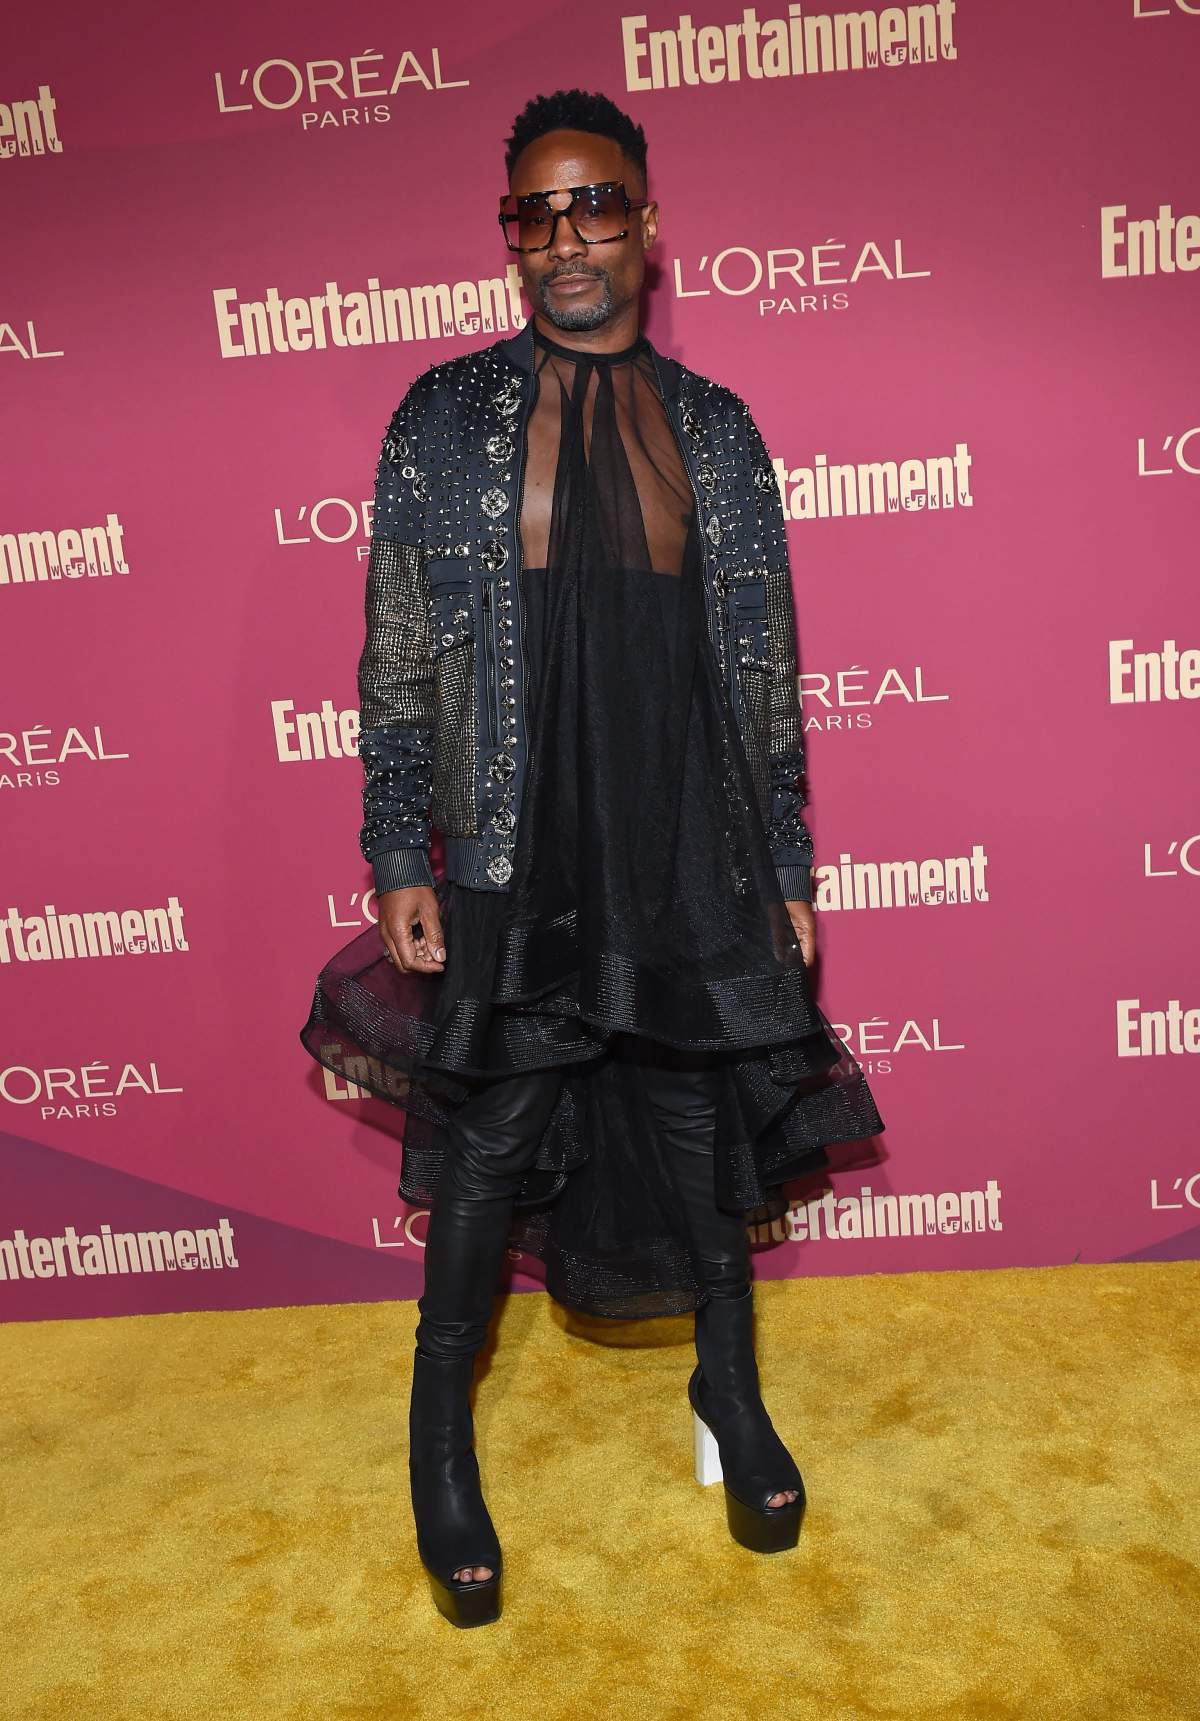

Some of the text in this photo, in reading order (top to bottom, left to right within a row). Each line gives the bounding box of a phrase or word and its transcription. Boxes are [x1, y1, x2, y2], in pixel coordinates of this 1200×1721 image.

[621, 0, 957, 92] Entertainment
[867, 43, 951, 65] WEEKLY
[214, 48, 470, 113] L'ORÉAL
[673, 238, 931, 298] L'ORÉAL
[213, 264, 526, 359] Entertainment
[443, 314, 520, 334] WEEKLY
[888, 491, 967, 510] WEEKLY
[51, 560, 124, 577] WEEKLY
[810, 845, 989, 912] ainment
[909, 888, 983, 904] WEEKLY
[114, 939, 183, 953] WEEKLY
[927, 1219, 998, 1233] WEEKLY
[166, 1255, 233, 1269] WEEKLY
